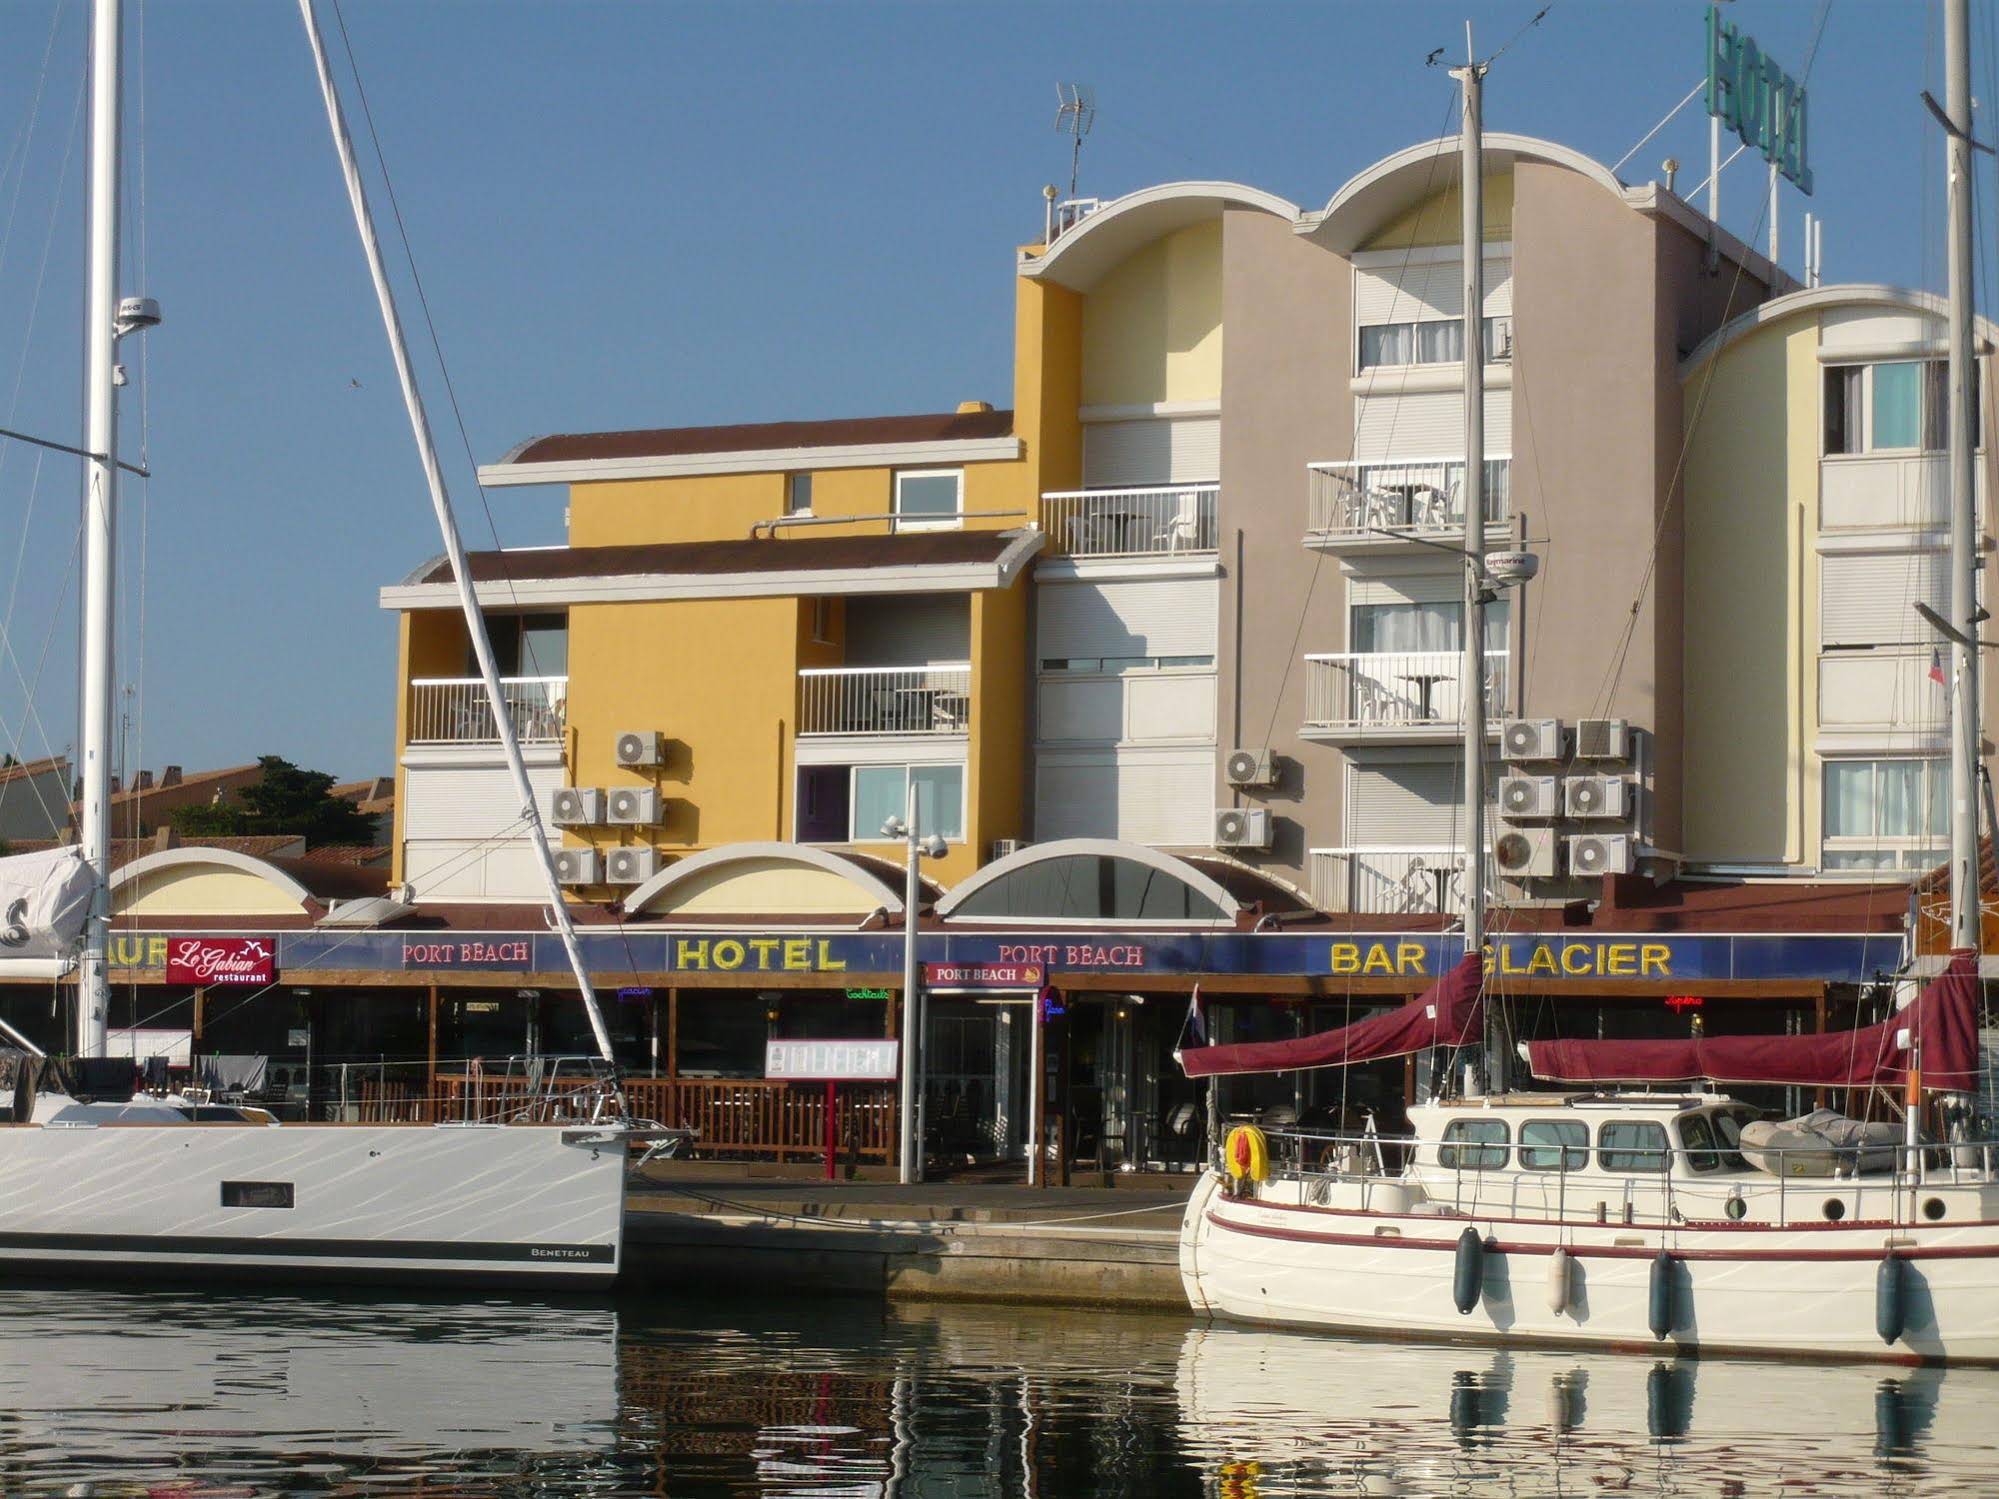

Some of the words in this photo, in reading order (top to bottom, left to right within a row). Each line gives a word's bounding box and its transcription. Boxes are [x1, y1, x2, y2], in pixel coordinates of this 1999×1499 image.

[170, 941, 201, 967] Le
[195, 947, 256, 978] Gabian
[401, 944, 455, 963] PORT
[459, 942, 528, 962] BEACH
[676, 939, 846, 971] HOTEL
[998, 944, 1058, 965] PORT
[1065, 944, 1144, 967] BEACH
[1330, 943, 1426, 974] BAR
[213, 974, 267, 983] restaurant
[936, 968, 970, 981] PORT
[973, 968, 1017, 981] BEACH
[530, 1247, 590, 1258] BENETEAU
